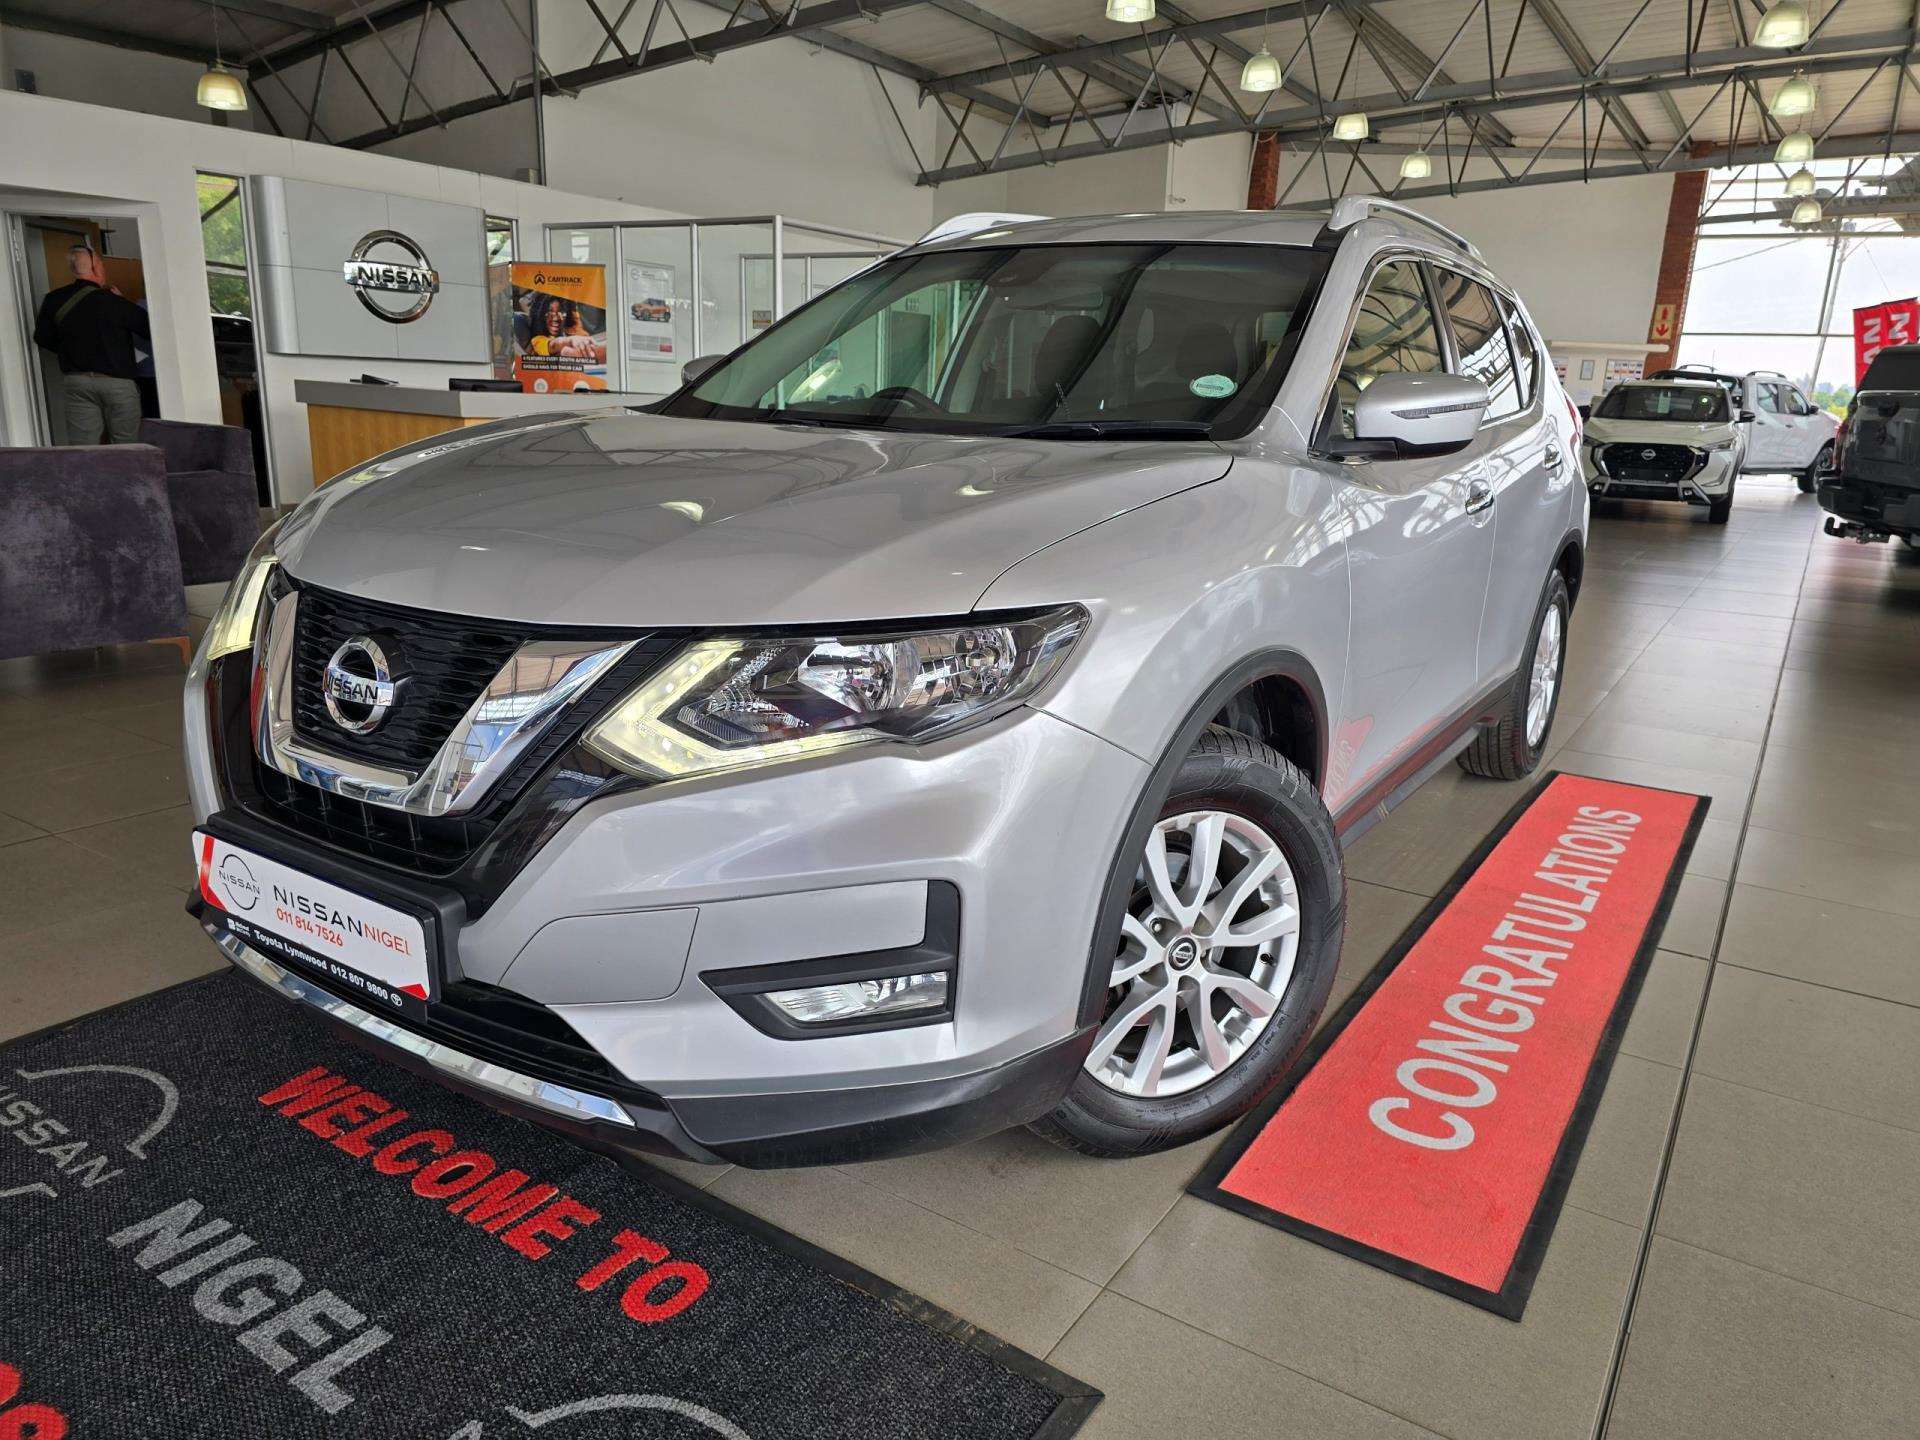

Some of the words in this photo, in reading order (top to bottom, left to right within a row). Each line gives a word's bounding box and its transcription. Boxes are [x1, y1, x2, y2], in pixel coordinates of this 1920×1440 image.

[358, 265, 432, 288] NISSAN
[547, 275, 583, 284] CARTRACK
[218, 870, 261, 895] NISSAN
[276, 909, 293, 927] 011
[295, 915, 314, 935] 814
[316, 924, 344, 948] 7526
[254, 929, 283, 951] Toyota
[285, 942, 328, 970] Lynnwood
[330, 963, 348, 980] 012
[366, 981, 389, 1000] 9800
[1368, 805, 1643, 1152] CONGRATULATIONS
[259, 1066, 601, 1261] WELCOME
[576, 1228, 711, 1323] TO
[108, 1198, 394, 1415] NIGEL
